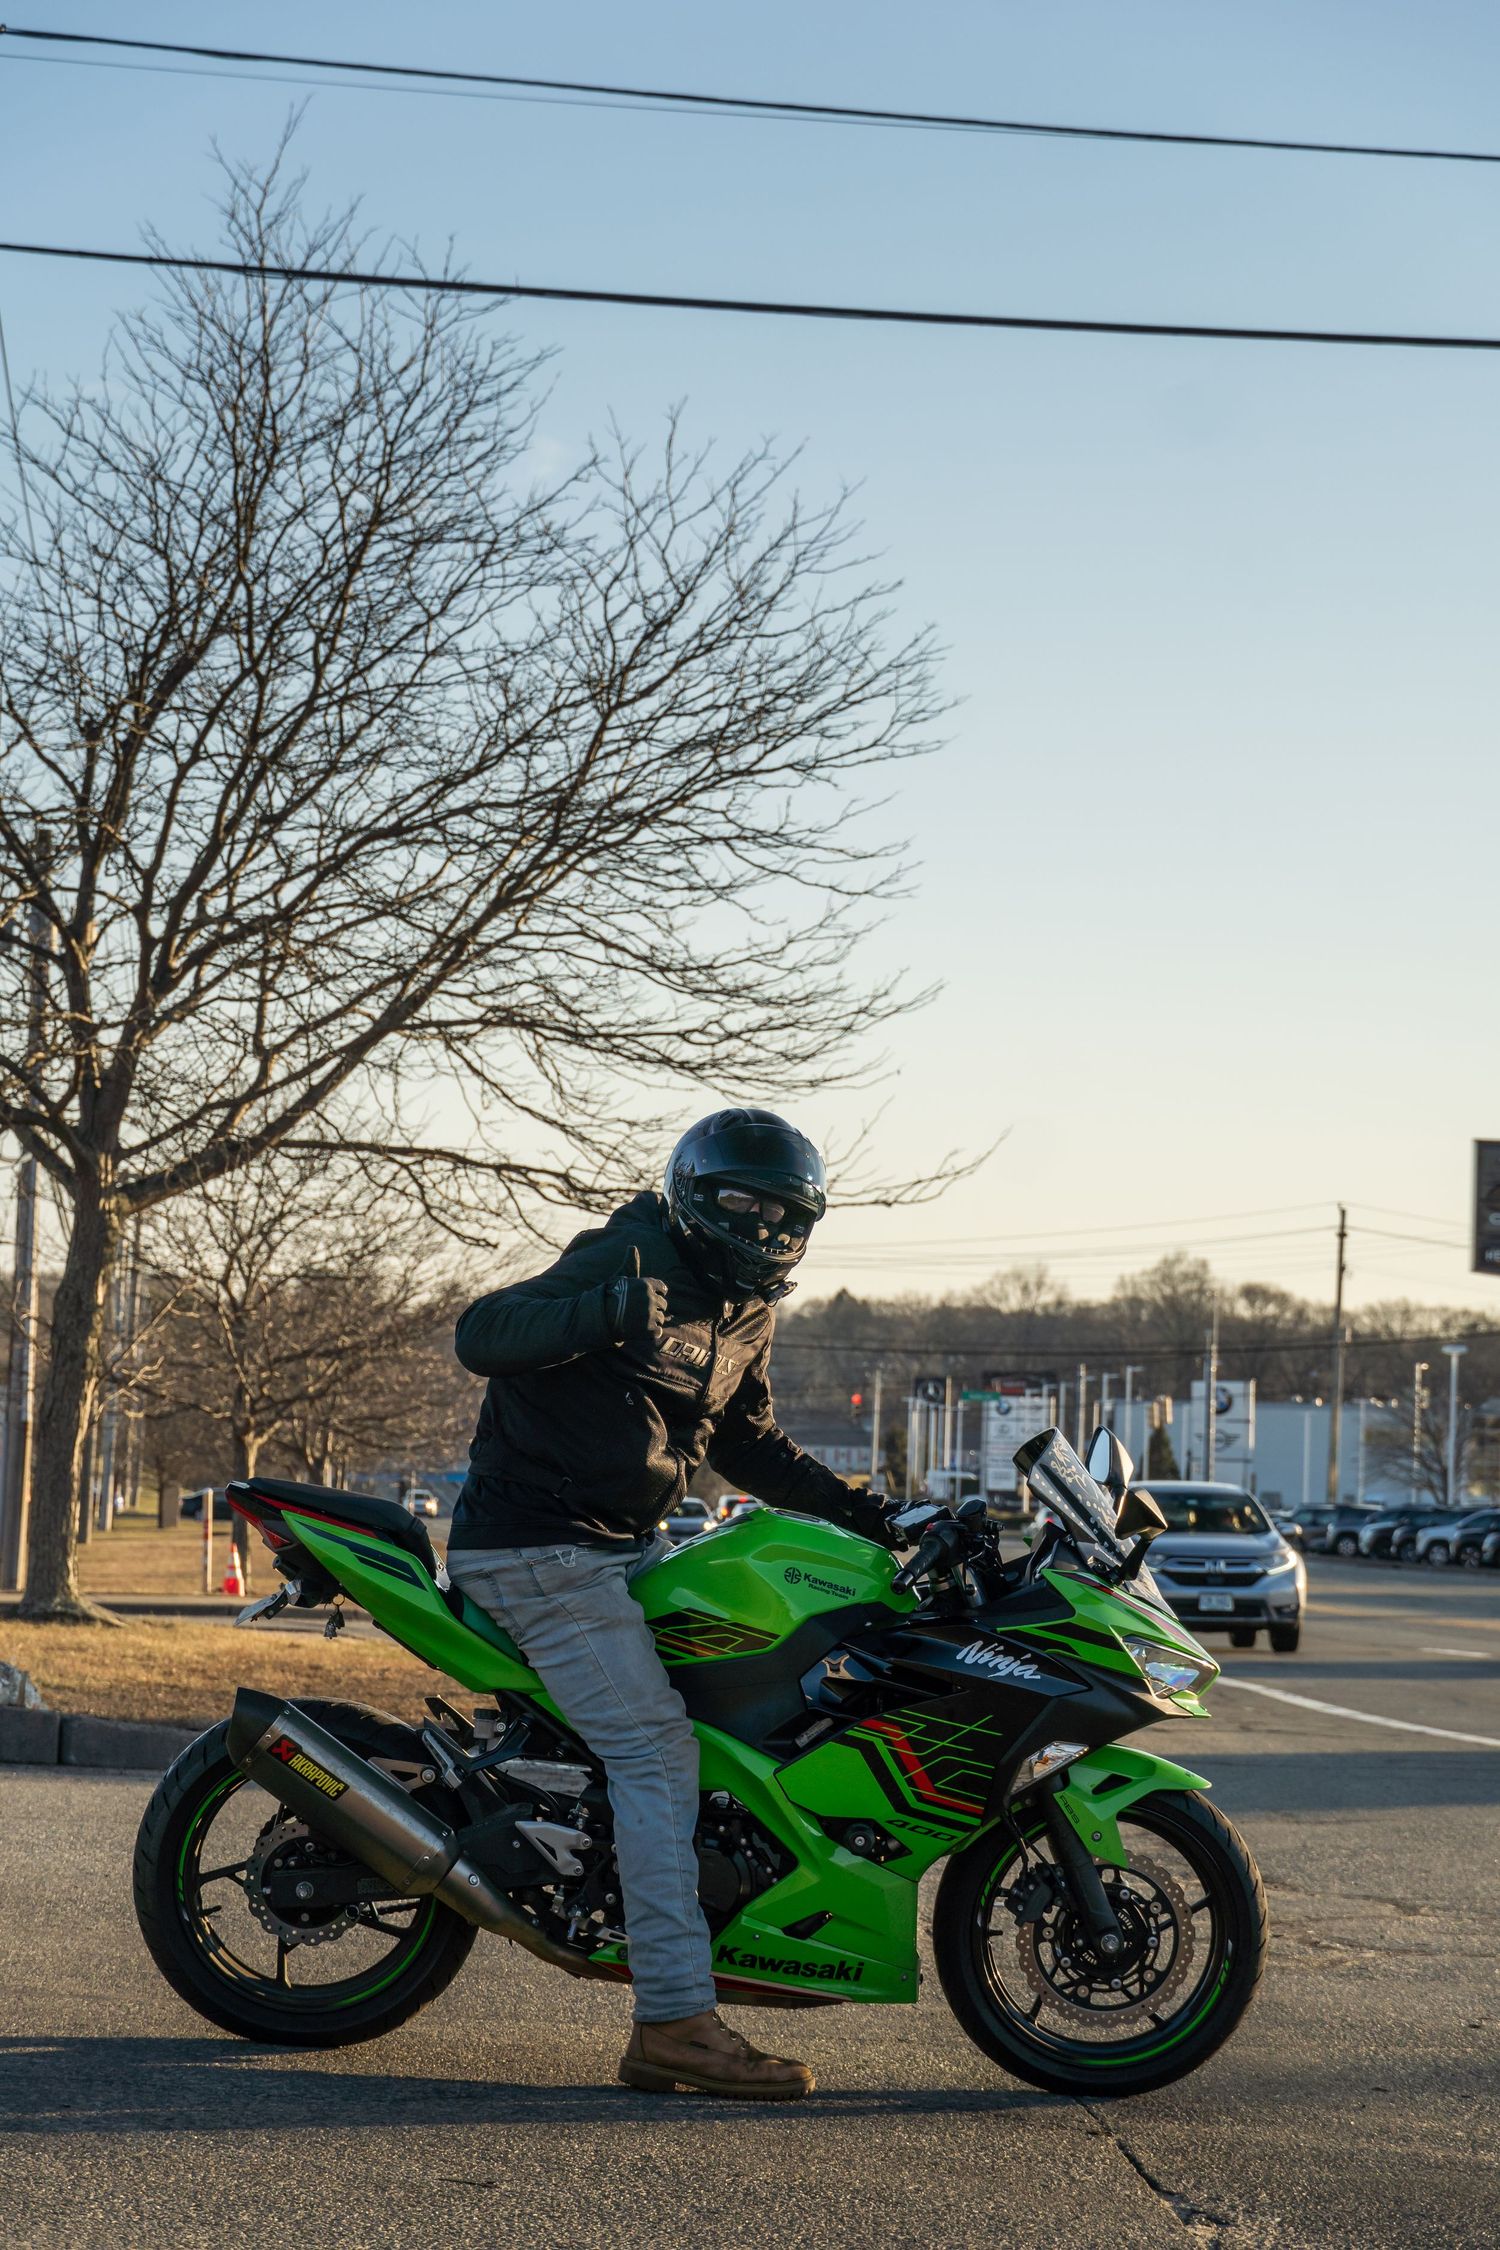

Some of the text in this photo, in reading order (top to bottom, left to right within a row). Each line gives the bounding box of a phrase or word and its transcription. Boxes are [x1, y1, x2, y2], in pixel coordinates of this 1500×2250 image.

[803, 1573, 857, 1597] Kawasaki
[956, 1640, 1041, 1679] Ninja
[885, 1820, 958, 1841] 400
[715, 1944, 865, 1982] Kawasaki
